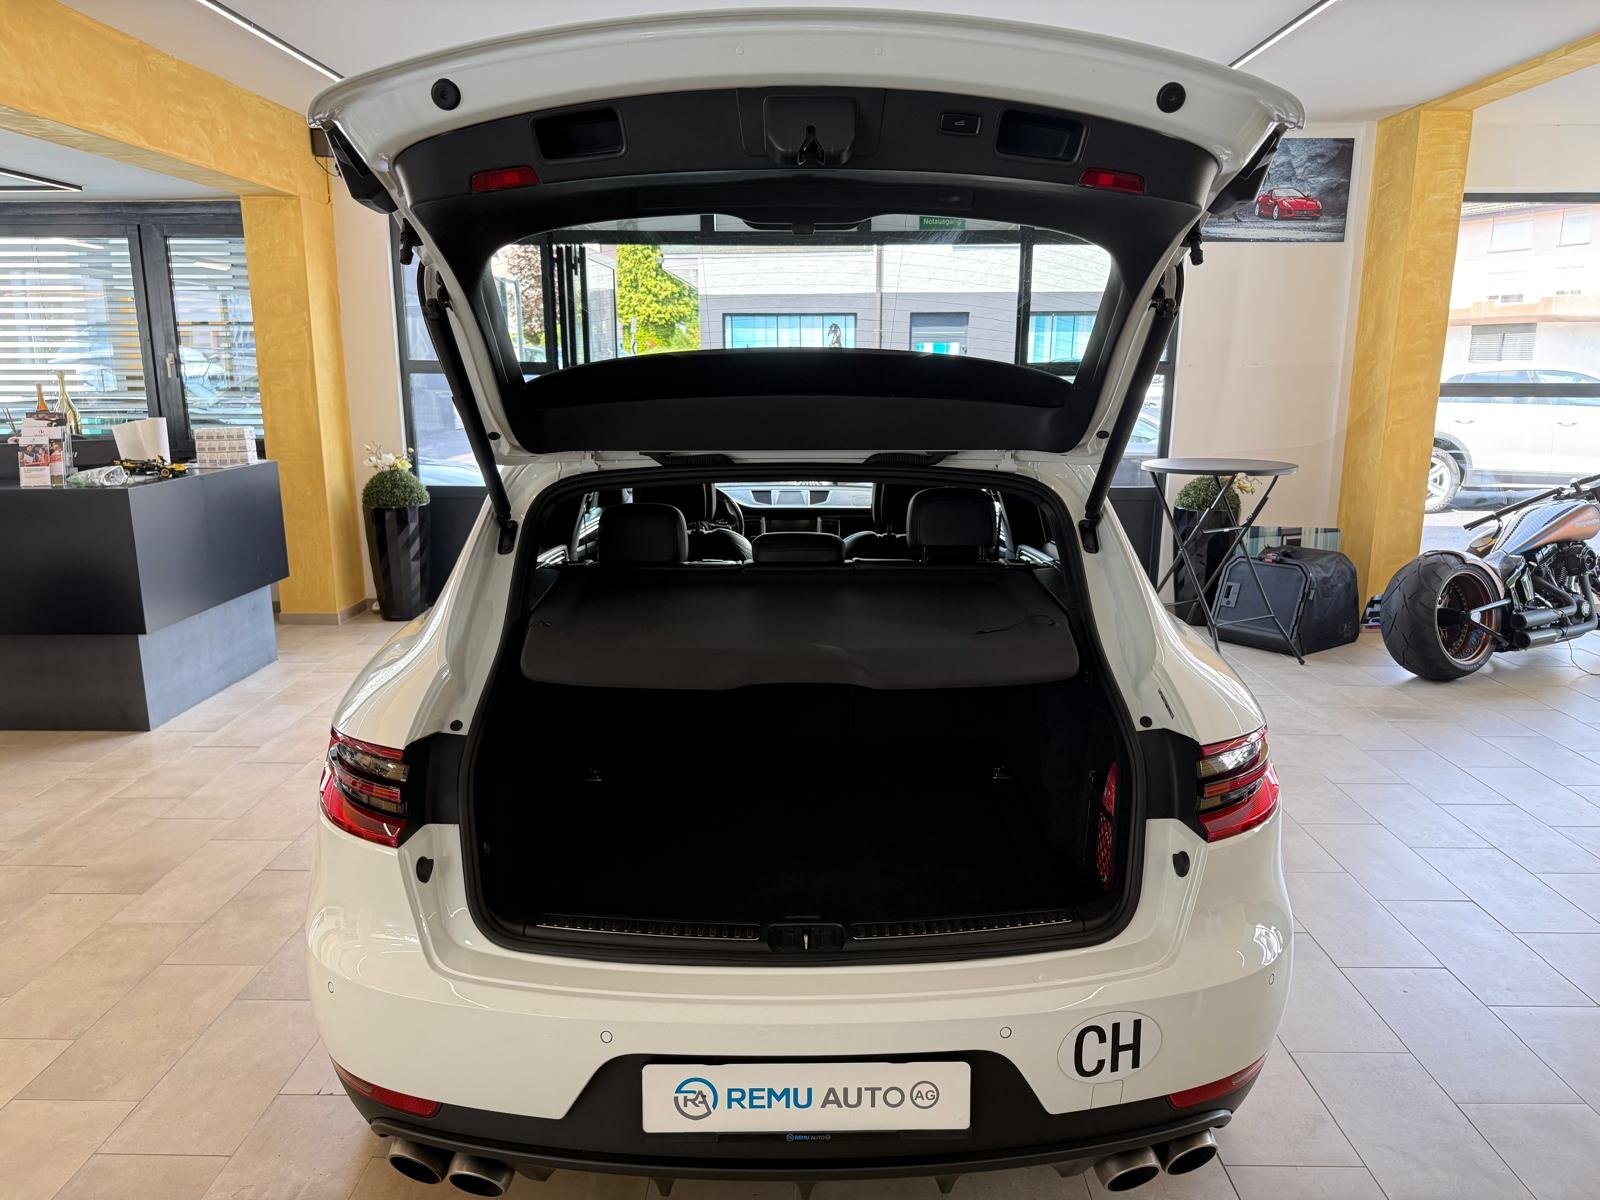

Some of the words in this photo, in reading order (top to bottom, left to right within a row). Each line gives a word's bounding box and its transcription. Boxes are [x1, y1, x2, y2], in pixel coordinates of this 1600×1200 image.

[1074, 1019, 1142, 1077] CH
[727, 1088, 812, 1109] REMU
[820, 1086, 905, 1108] AUTO
[914, 1090, 936, 1101] AG
